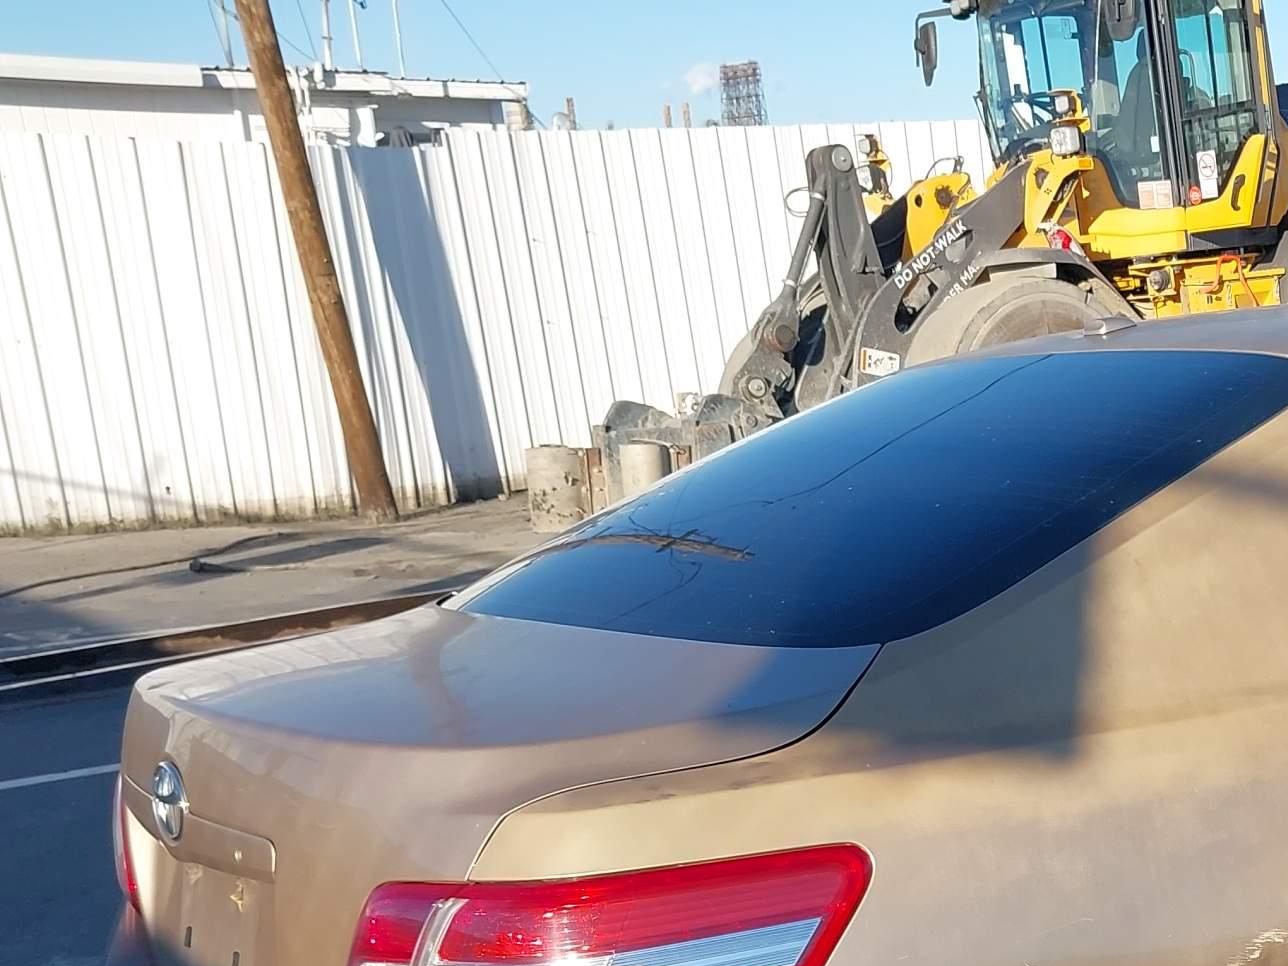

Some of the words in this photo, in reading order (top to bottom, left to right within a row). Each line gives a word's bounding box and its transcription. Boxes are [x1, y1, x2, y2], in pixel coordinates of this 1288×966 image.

[894, 269, 913, 289] DO
[911, 247, 937, 273] NOT
[934, 219, 967, 252] WALK
